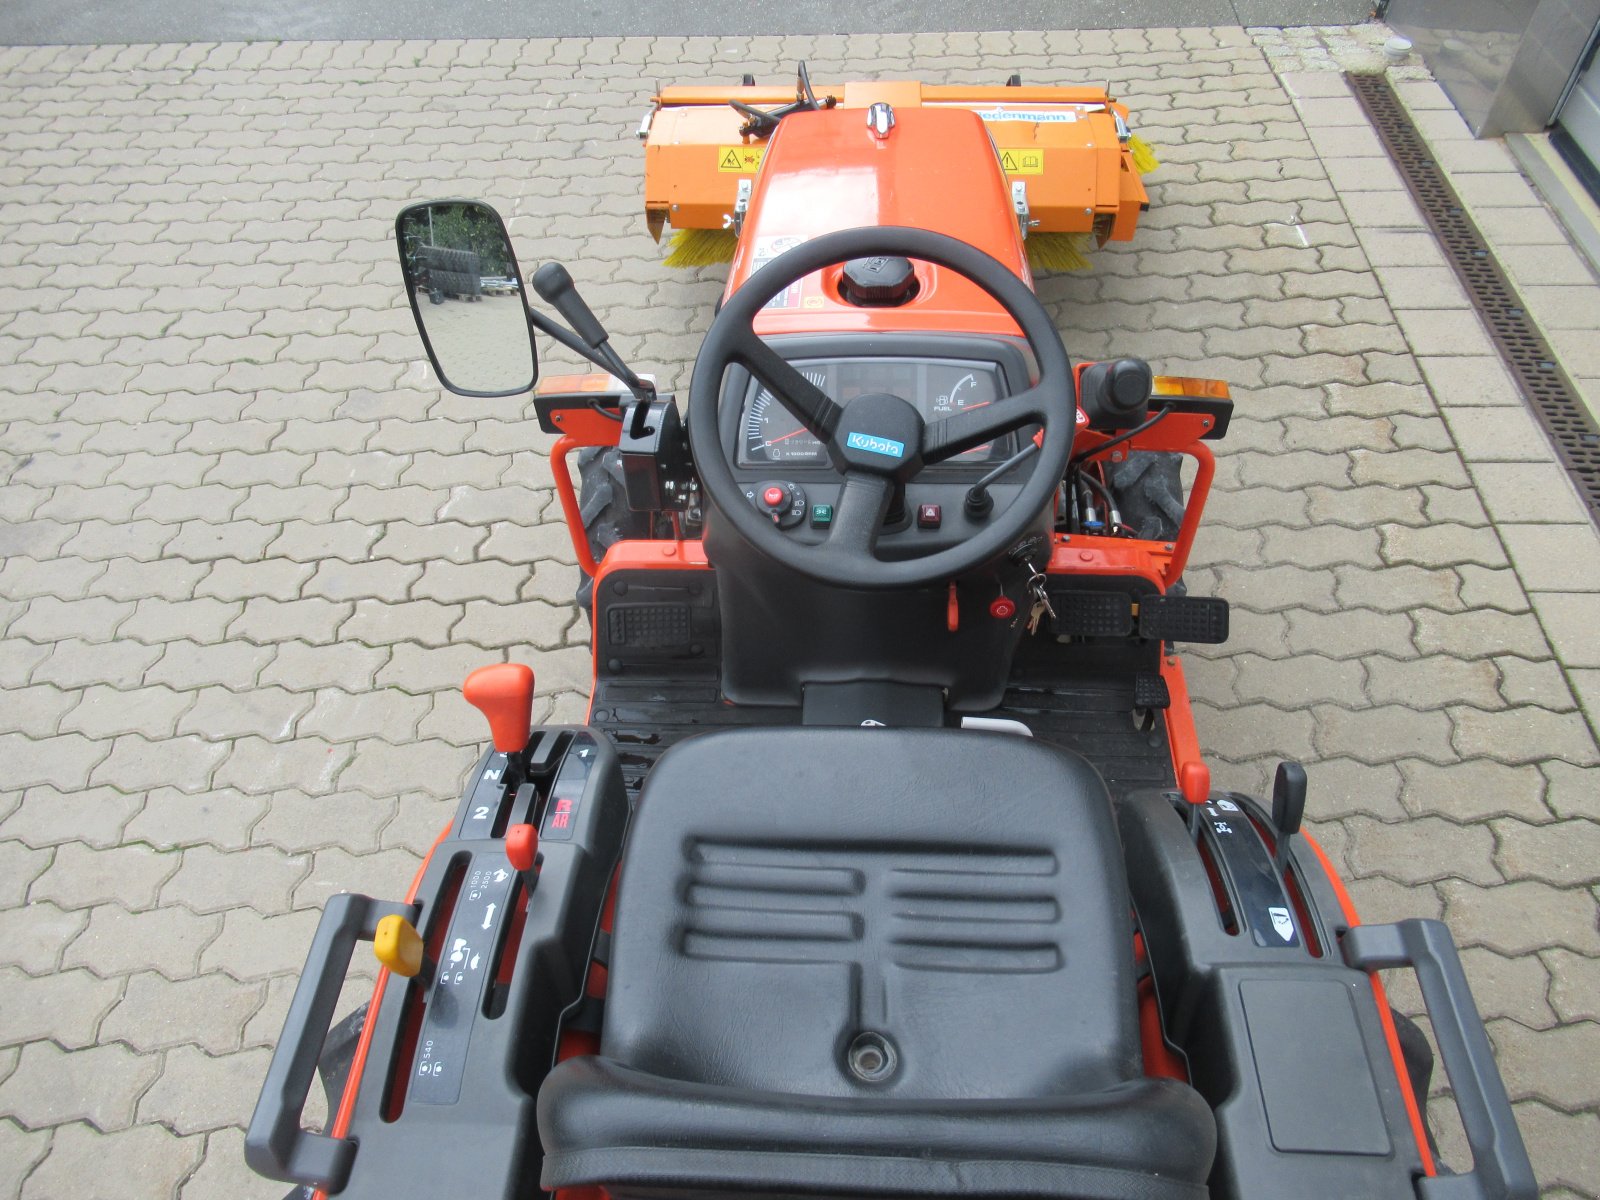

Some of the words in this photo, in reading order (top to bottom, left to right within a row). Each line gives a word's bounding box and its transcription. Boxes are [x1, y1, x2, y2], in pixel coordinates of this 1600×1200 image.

[851, 434, 899, 455] Kubota
[580, 748, 590, 758] 1
[483, 769, 502, 780] N
[472, 806, 490, 820] 2
[556, 799, 573, 812] R
[551, 813, 570, 829] AR
[470, 870, 482, 888] 1000
[480, 870, 492, 889] 2500
[423, 1040, 434, 1059] 540
